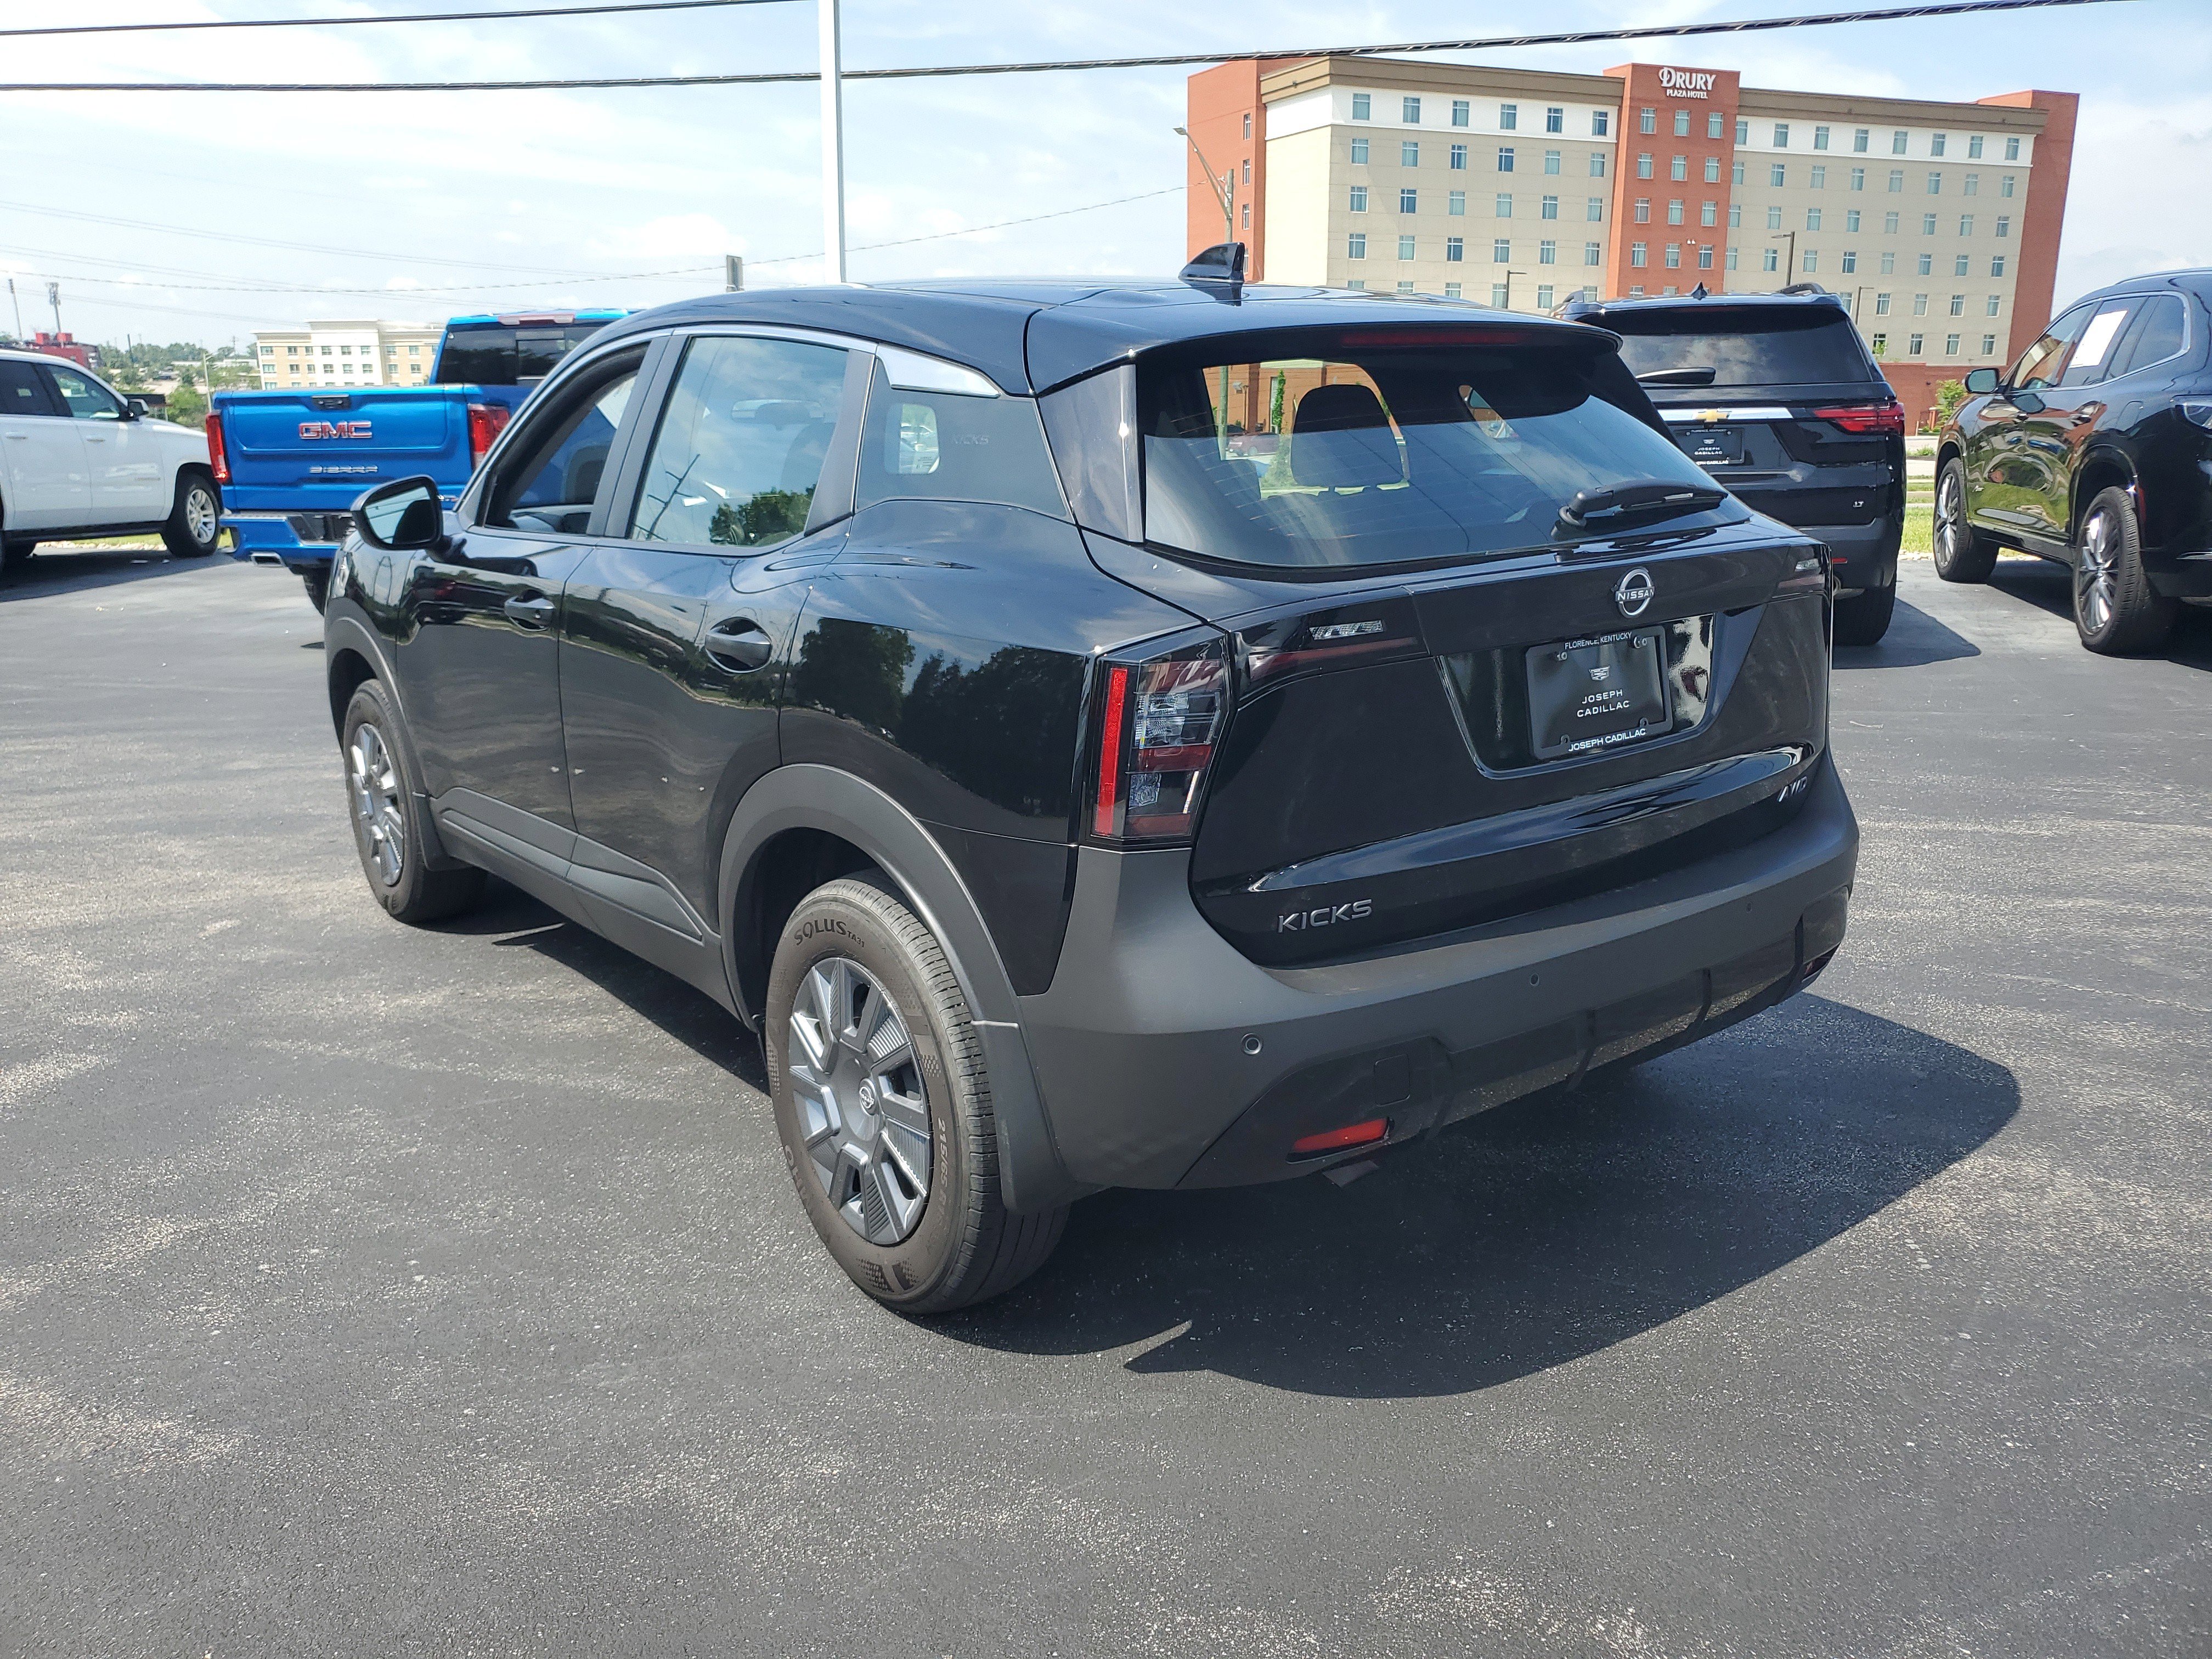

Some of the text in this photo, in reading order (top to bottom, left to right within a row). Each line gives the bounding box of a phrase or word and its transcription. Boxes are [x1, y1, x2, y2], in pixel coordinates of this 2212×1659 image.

[1658, 67, 1717, 91] DRURY
[1666, 88, 1708, 99] PLAZA HOTEL
[299, 420, 373, 439] GMC
[1617, 588, 1654, 601] NISSAN
[1600, 631, 1633, 644] KENTUCKY
[1582, 689, 1623, 704] JOSEPH
[1577, 700, 1630, 718] CADILLAC
[1568, 728, 1646, 752] JOSEPH CADILLAC
[1277, 899, 1372, 933] KICKS
[794, 918, 865, 948] SOLUS TA31
[938, 1117, 948, 1188] 215/65
